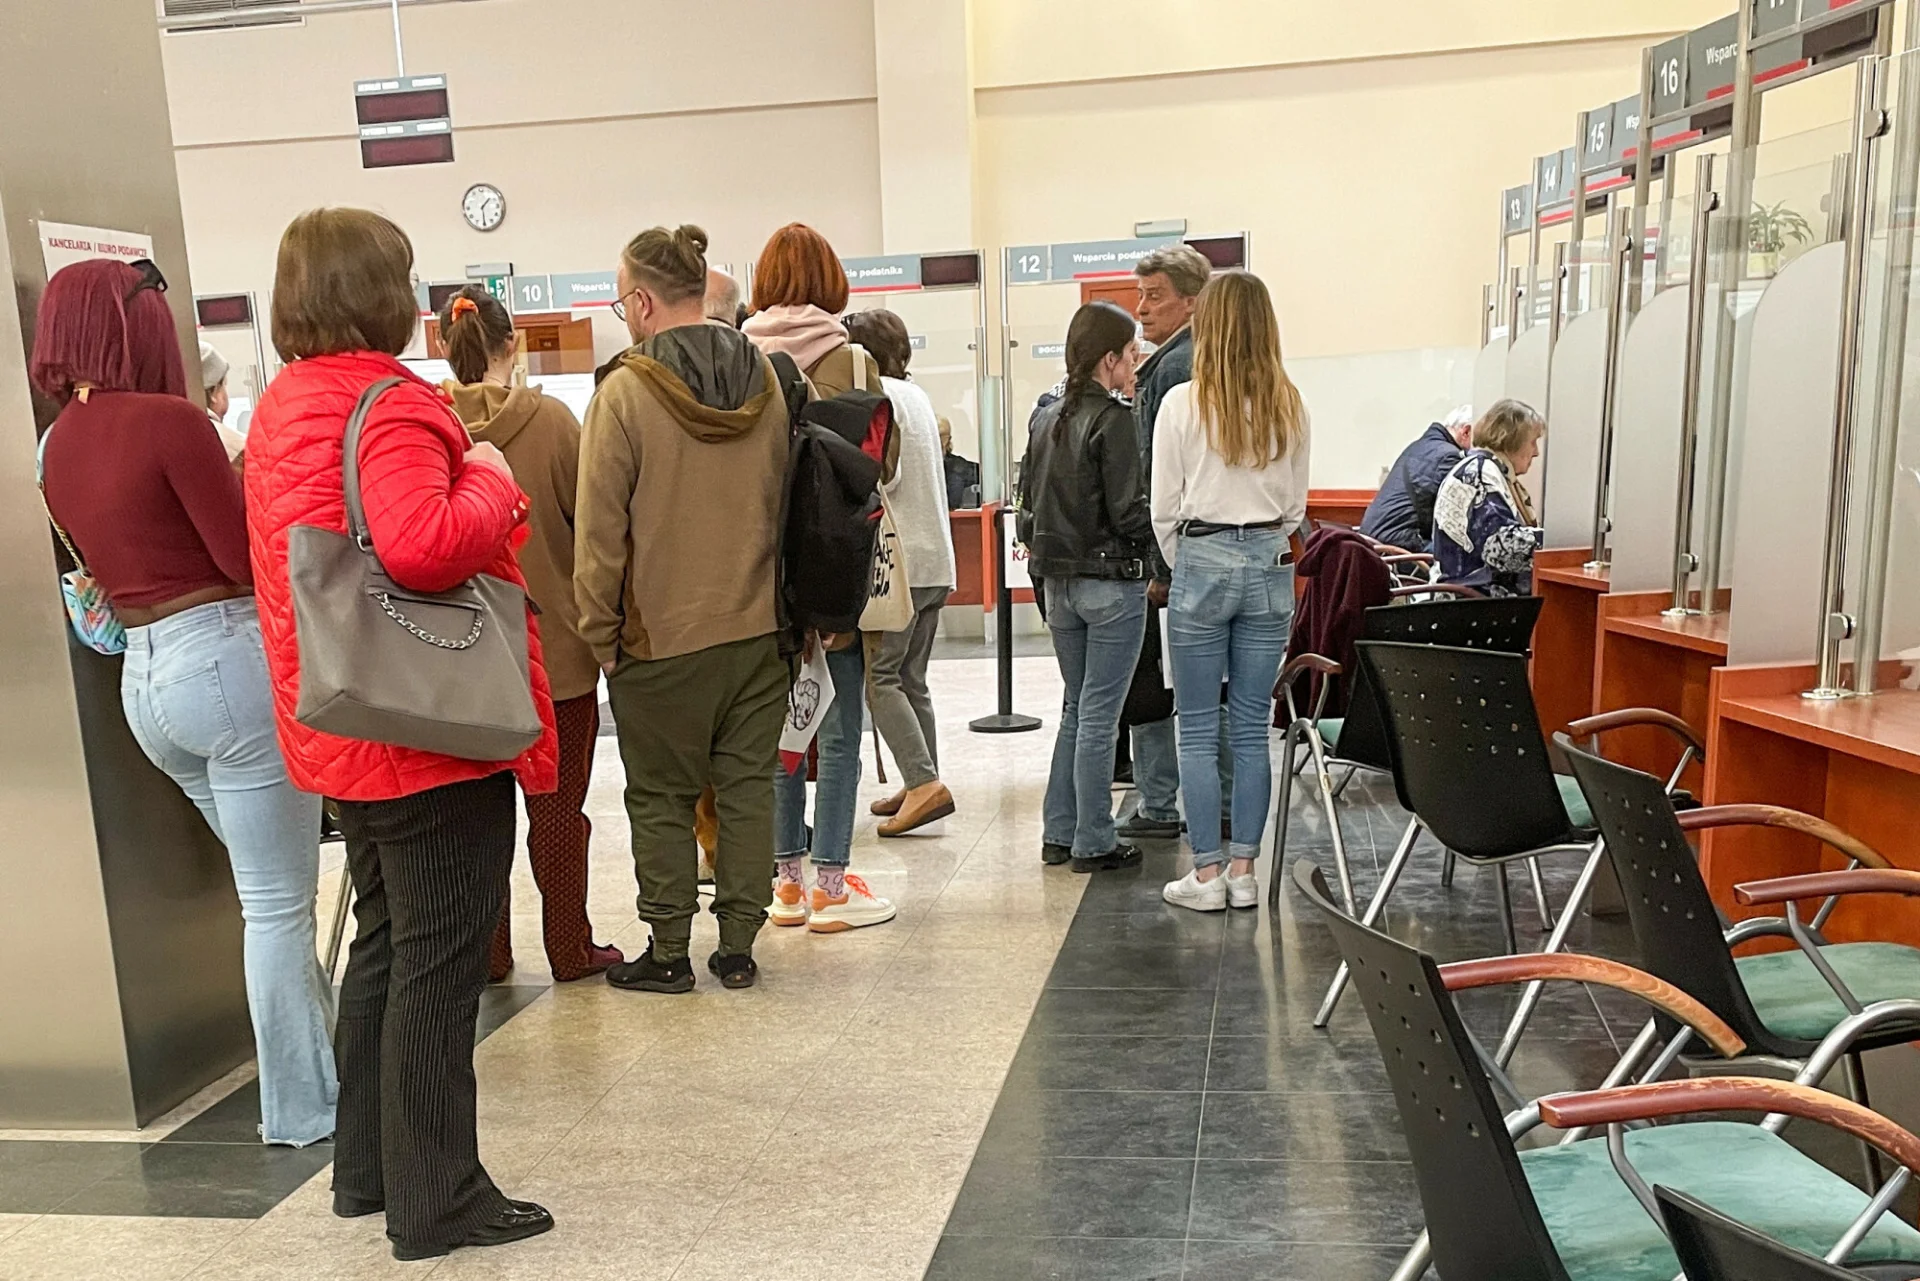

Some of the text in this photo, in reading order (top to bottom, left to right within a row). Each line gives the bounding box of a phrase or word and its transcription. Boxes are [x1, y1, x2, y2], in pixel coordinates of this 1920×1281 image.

[1660, 43, 1738, 97] 16 Wsparc
[1591, 114, 1641, 153] 15 Wsp
[1544, 166, 1556, 192] 14
[1510, 198, 1521, 220] 13
[859, 265, 903, 279] podatnika
[1018, 255, 1041, 274] 12
[1072, 252, 1116, 264] Wsparcie
[522, 284, 542, 302] 10
[570, 281, 611, 293] Wsparcie
[1012, 549, 1031, 561] KA
